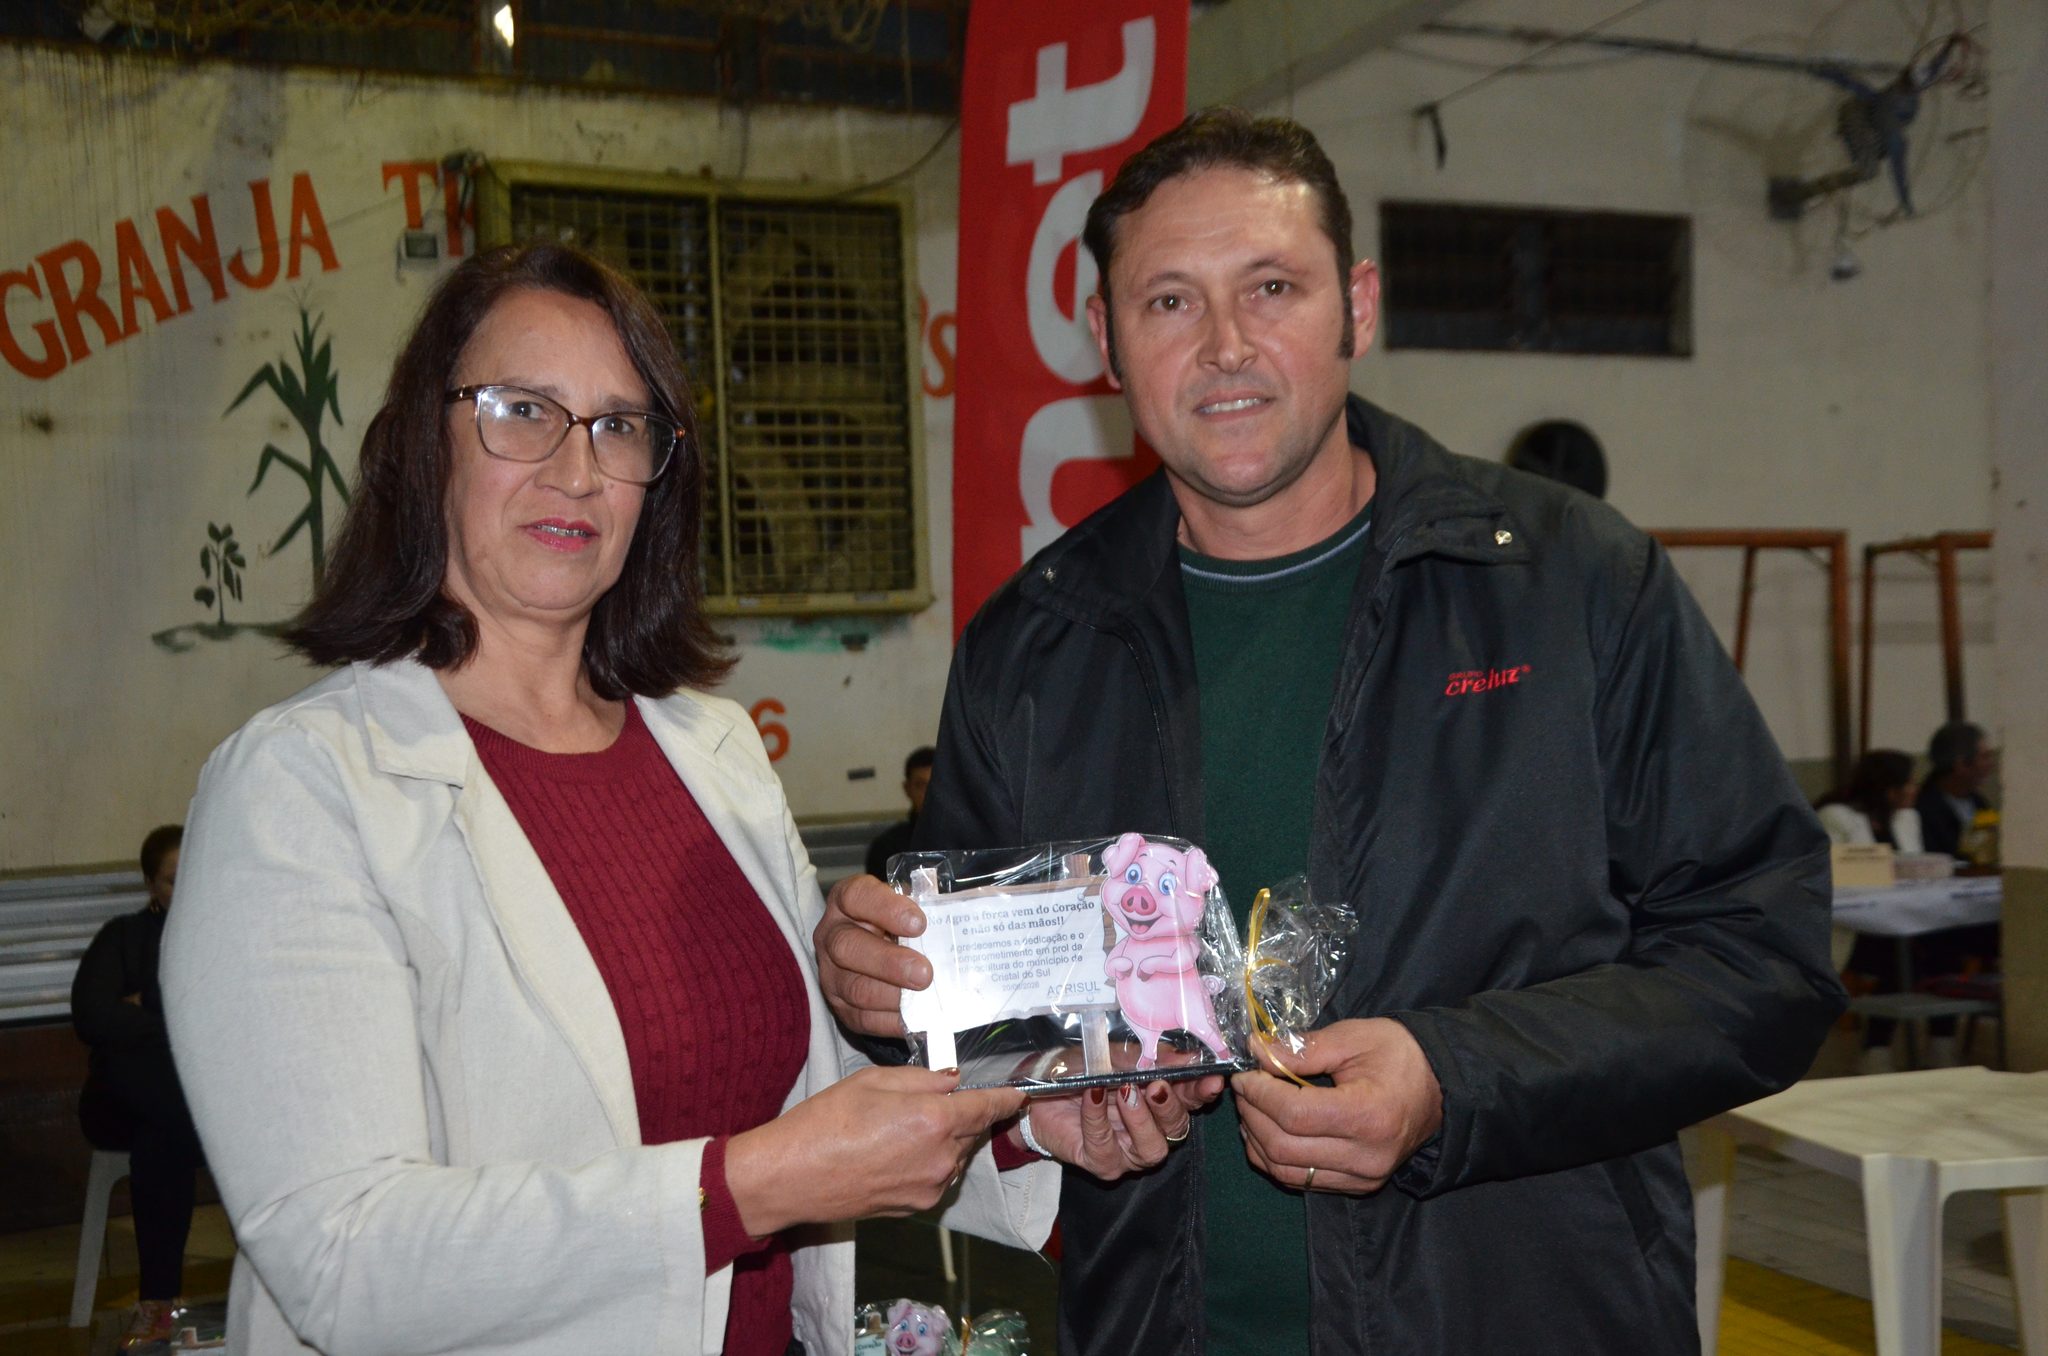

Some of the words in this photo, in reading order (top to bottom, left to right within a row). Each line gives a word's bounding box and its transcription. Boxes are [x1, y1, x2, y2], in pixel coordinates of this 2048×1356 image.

[0, 170, 341, 381] GRANJA
[946, 913, 970, 926] Agro
[982, 909, 1009, 922] força
[1011, 907, 1034, 917] vem
[1036, 904, 1050, 914] do
[1052, 901, 1095, 913] Coração
[962, 927, 969, 935] e
[971, 923, 991, 935] não
[993, 920, 1005, 932] só
[1007, 920, 1026, 931] das
[1028, 916, 1064, 929] mãos!!
[1022, 933, 1068, 945] dedicação
[1035, 946, 1050, 955] em
[1052, 943, 1069, 954] prol
[1012, 960, 1024, 969] do
[991, 971, 1020, 982] Cristal
[1022, 970, 1034, 979] do
[1036, 968, 1051, 978] Sul
